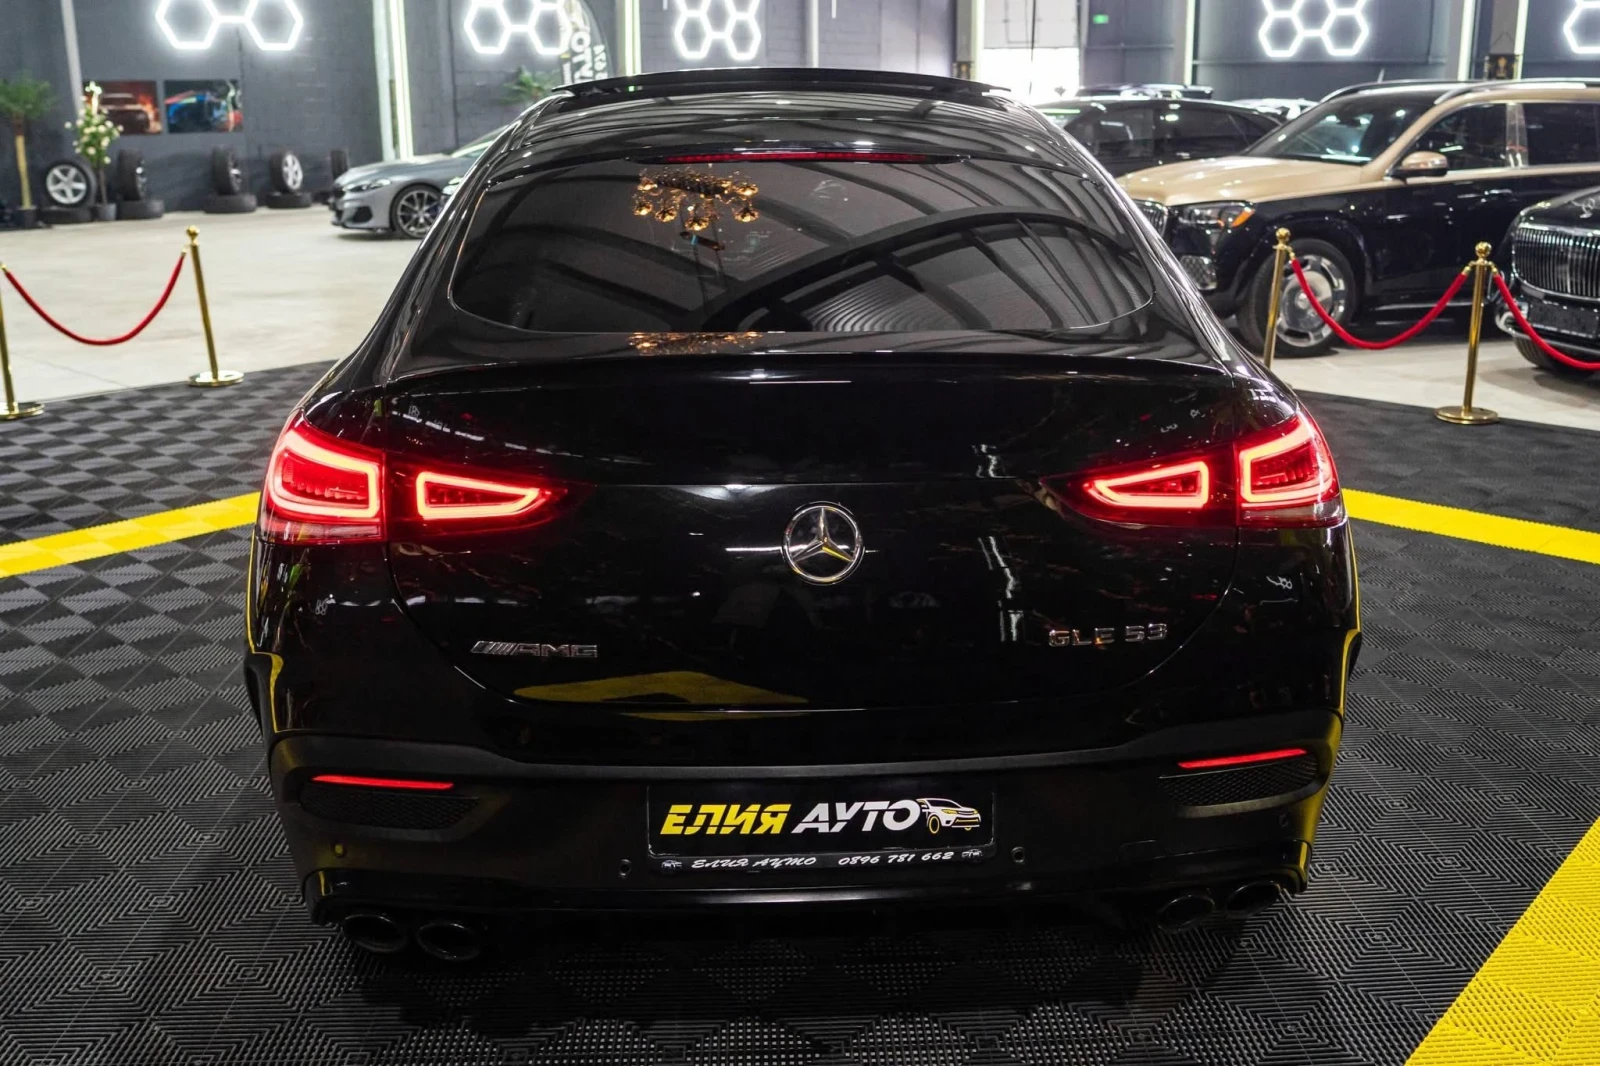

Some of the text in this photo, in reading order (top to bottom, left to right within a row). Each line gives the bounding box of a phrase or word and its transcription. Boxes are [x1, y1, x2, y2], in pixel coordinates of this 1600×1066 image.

[1049, 623, 1168, 647] GLE 53
[511, 643, 598, 658] AMG
[660, 799, 920, 835] ЕЛИЯ АУТО
[838, 855, 881, 866] 0896
[887, 853, 916, 864] 781
[921, 851, 954, 861] 662
